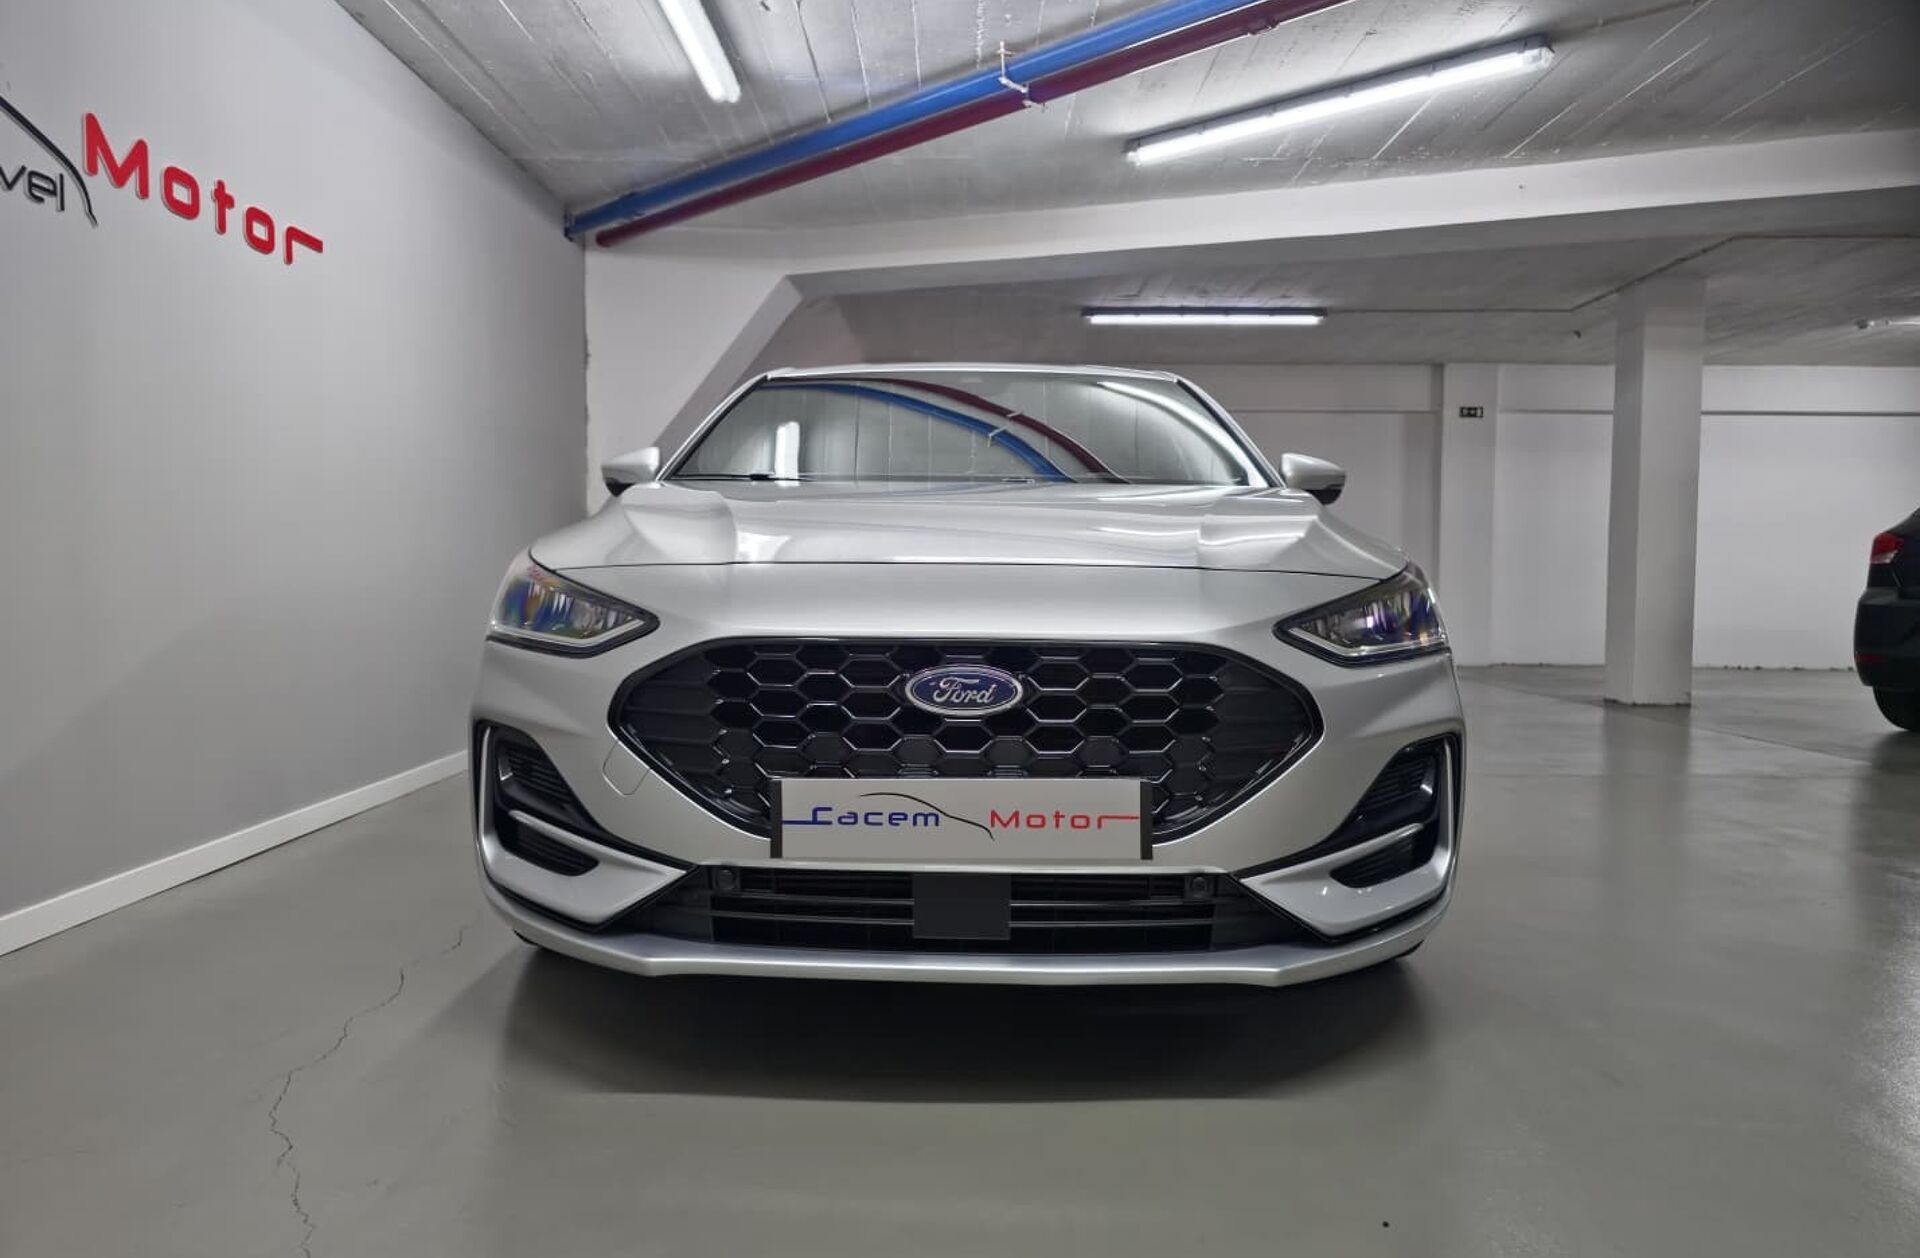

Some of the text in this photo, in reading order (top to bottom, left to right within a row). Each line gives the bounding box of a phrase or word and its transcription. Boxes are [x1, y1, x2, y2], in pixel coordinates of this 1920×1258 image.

[83, 112, 323, 265] Motor
[929, 676, 998, 704] Ford
[783, 806, 1139, 830] Cacem Motor
